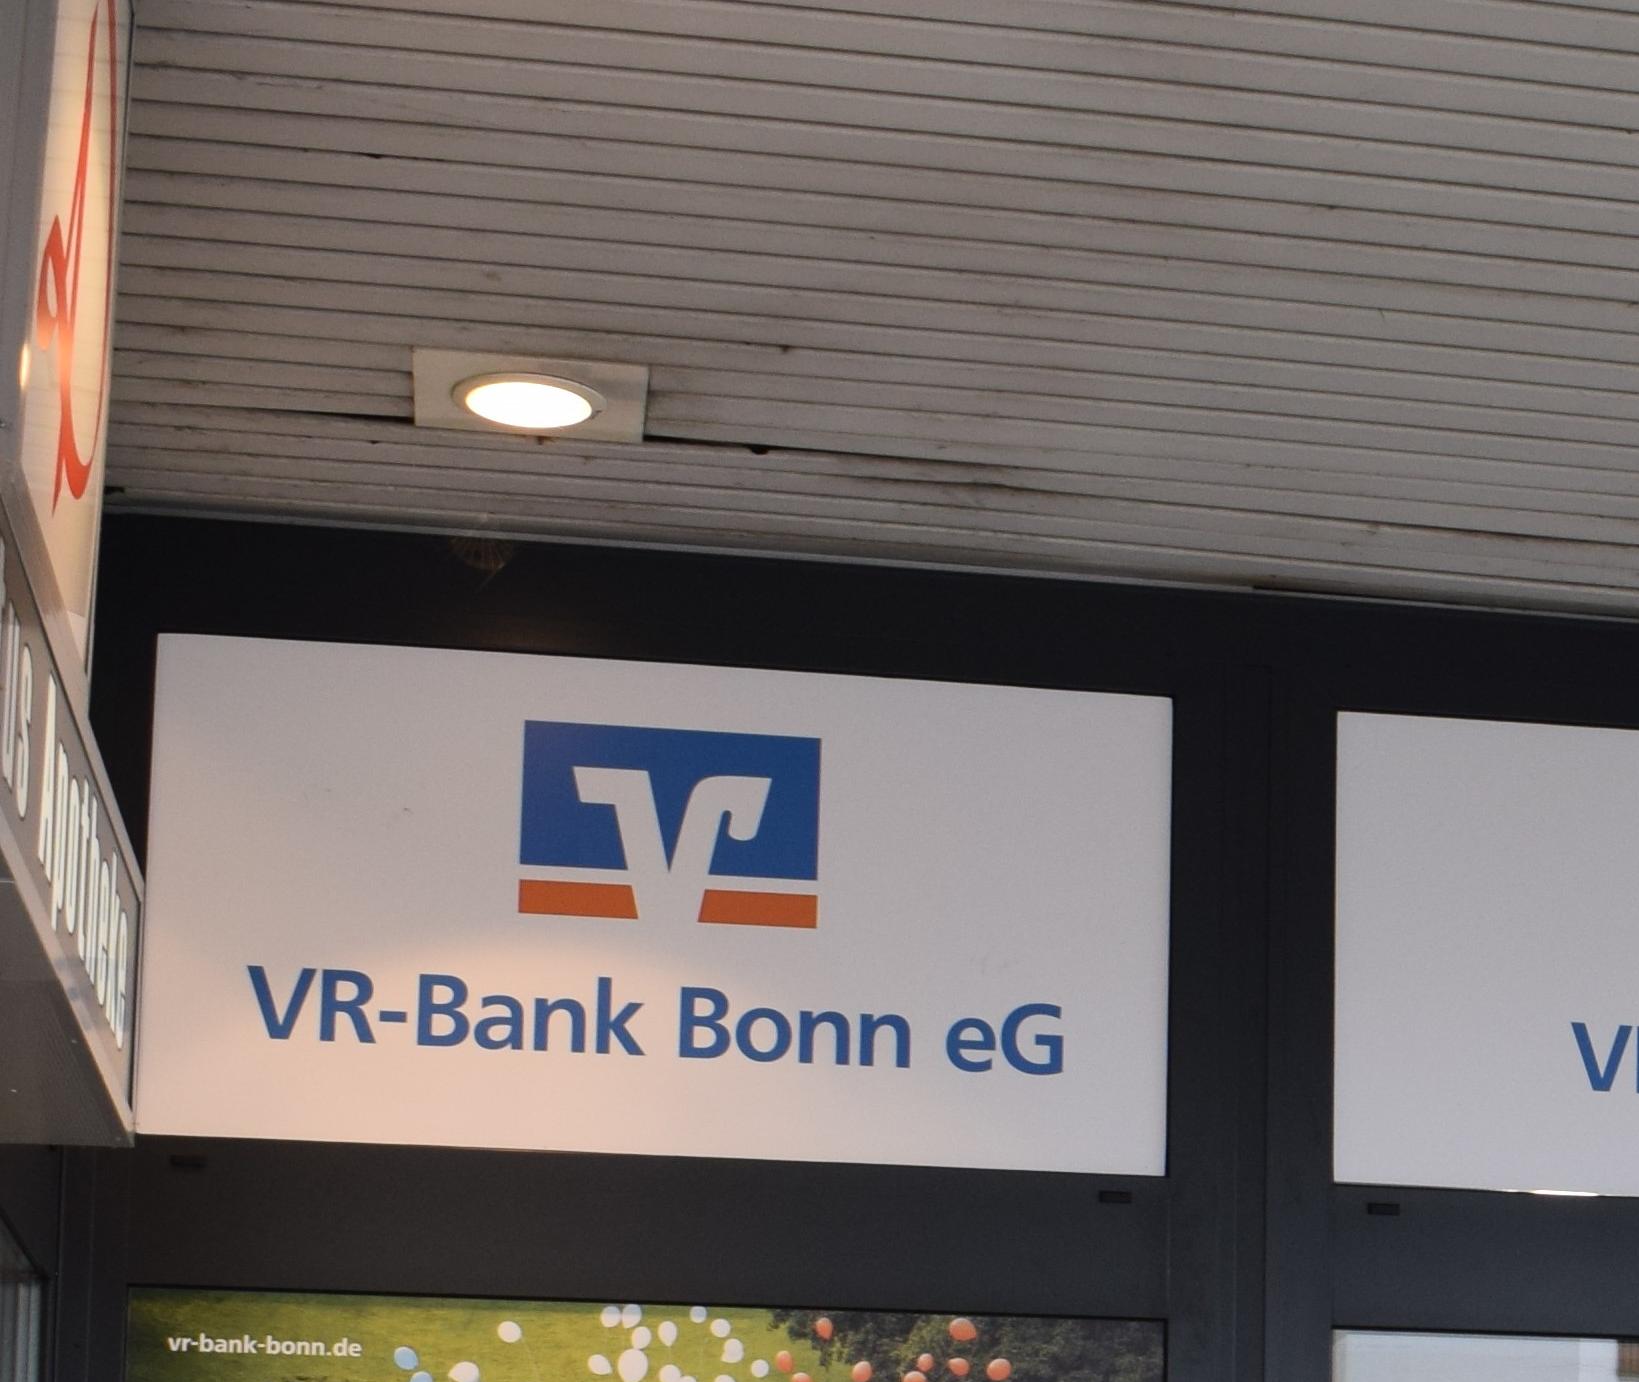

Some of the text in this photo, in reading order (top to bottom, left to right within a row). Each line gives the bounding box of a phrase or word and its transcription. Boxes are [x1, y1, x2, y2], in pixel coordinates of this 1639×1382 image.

[37, 671, 129, 1050] Apotheke
[248, 966, 1064, 1076] VR-Bank Bonn eG
[167, 1334, 362, 1358] vr-bank-bonn.de
